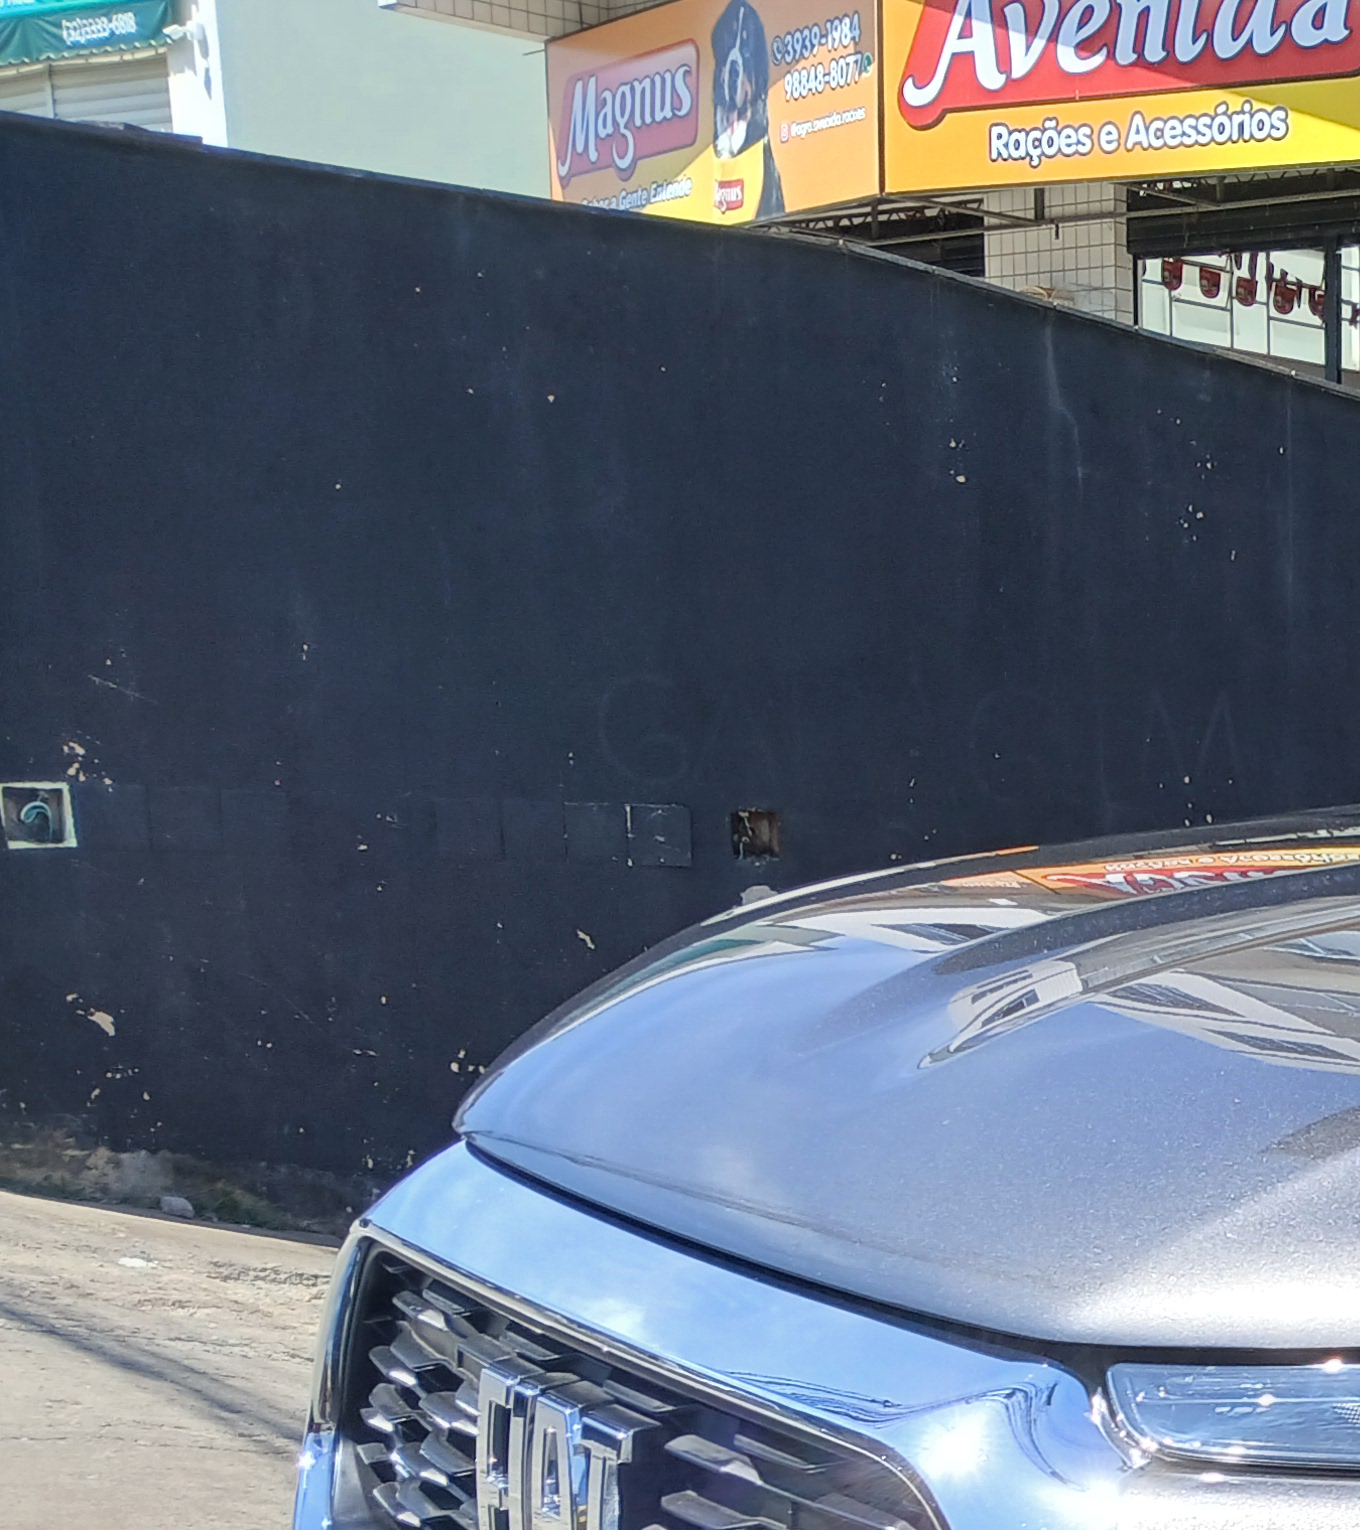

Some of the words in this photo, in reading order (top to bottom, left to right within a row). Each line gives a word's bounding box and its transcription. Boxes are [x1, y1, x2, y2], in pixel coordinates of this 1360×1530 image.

[784, 11, 861, 63] 3939-1984
[784, 53, 863, 102] 98848-8077
[558, 64, 692, 177] Magnus
[989, 120, 1093, 167] Rações
[1099, 130, 1120, 151] e
[1126, 101, 1290, 151] Acessórios
[619, 189, 648, 210] Gente
